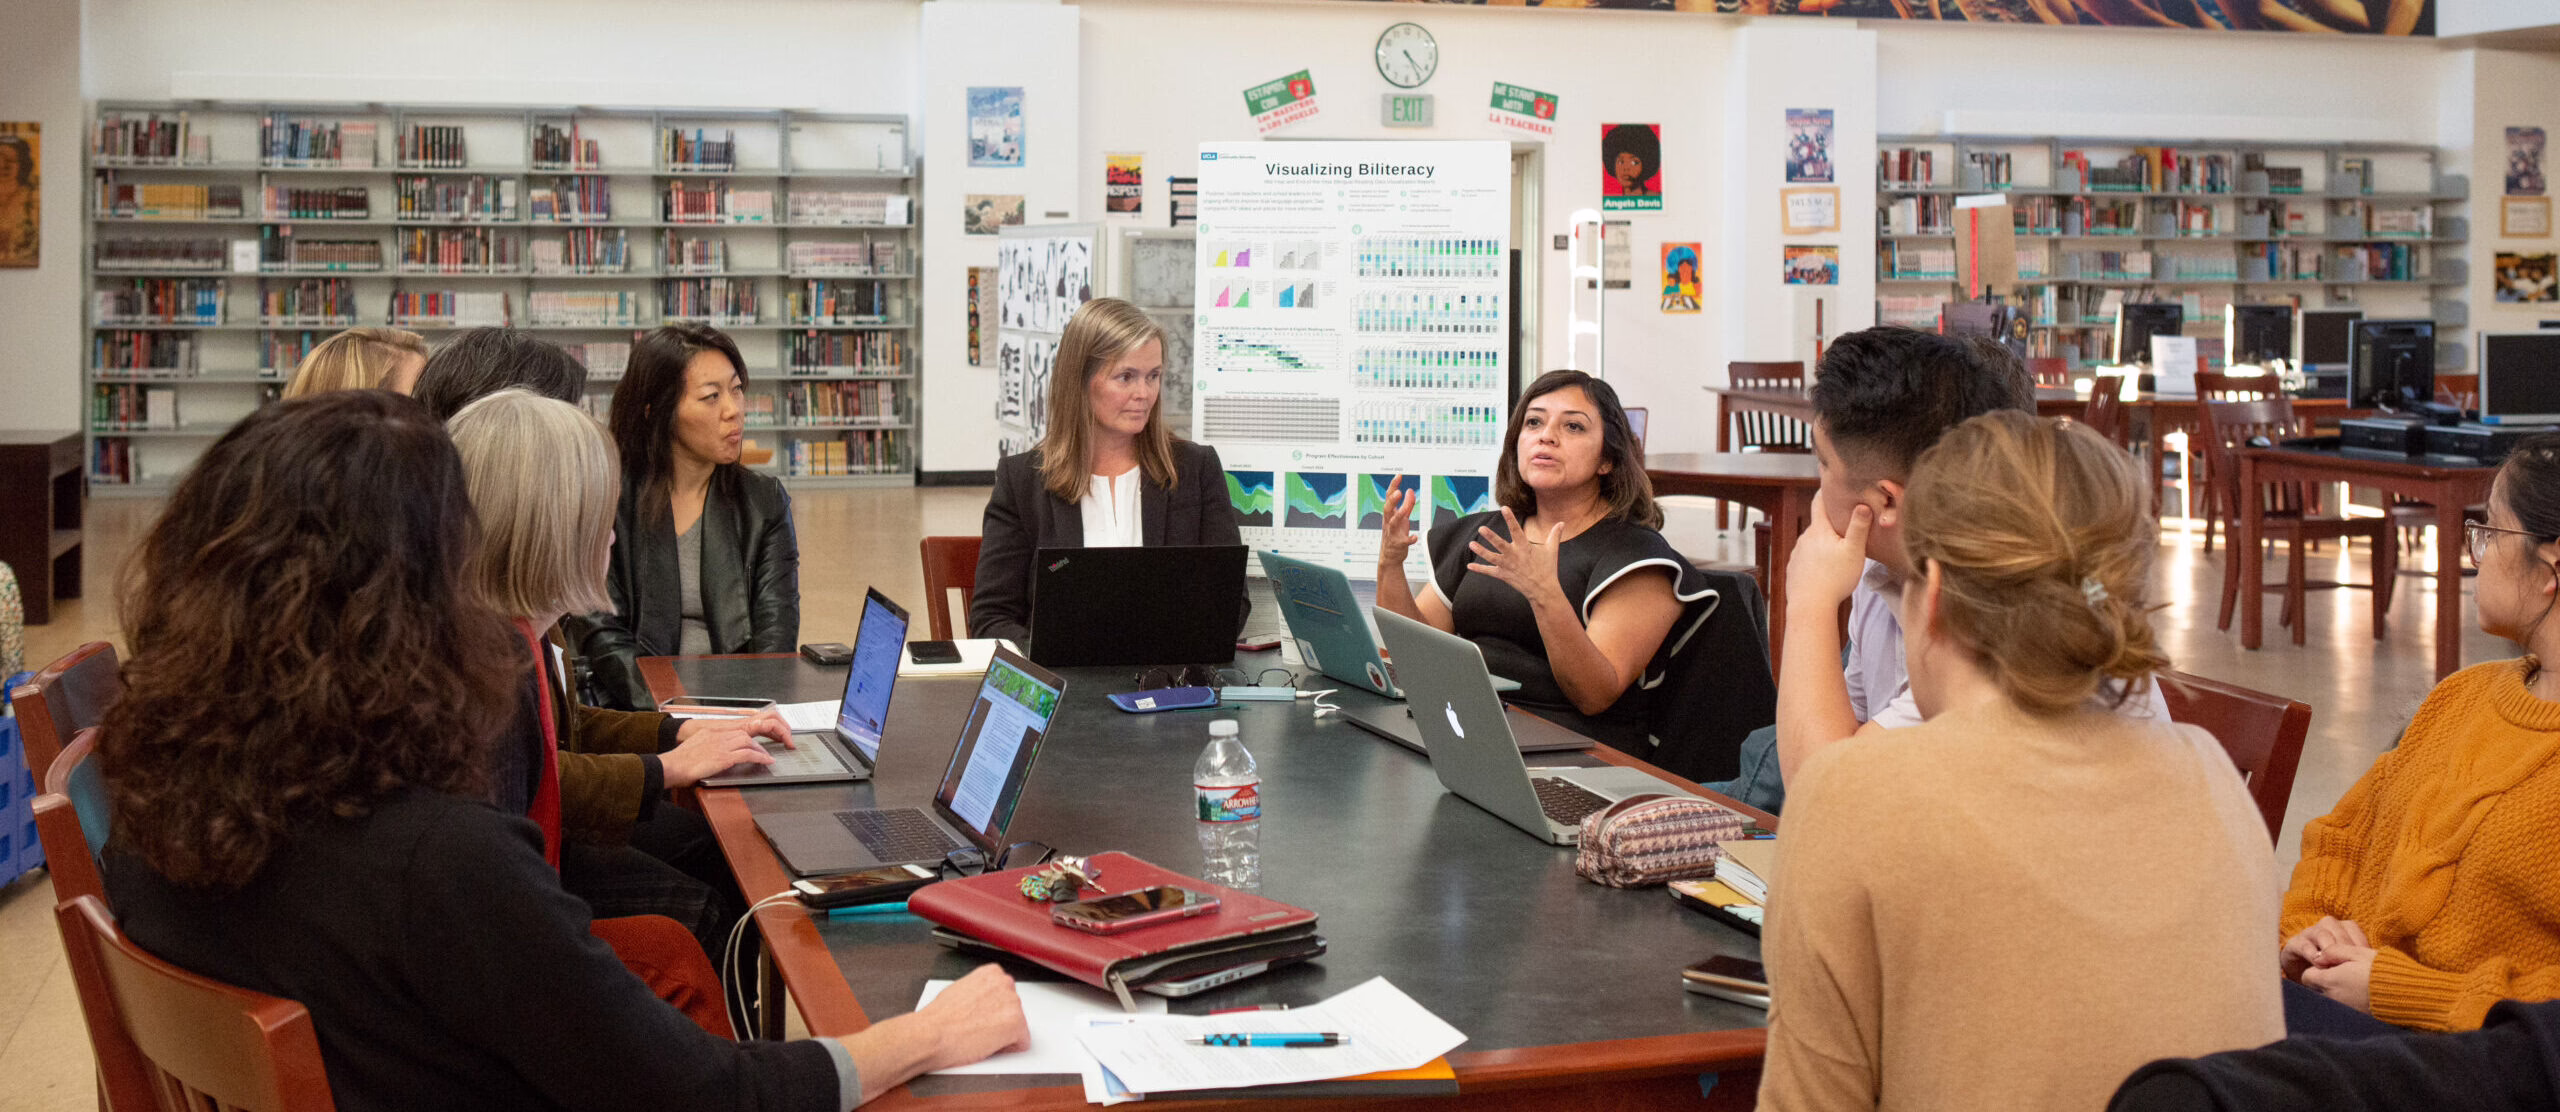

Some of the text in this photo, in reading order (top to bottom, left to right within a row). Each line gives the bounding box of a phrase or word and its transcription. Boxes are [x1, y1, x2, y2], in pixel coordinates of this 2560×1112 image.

[1508, 87, 1536, 102] STAND
[1393, 97, 1424, 122] EXIT
[1489, 113, 1553, 135] LA TEACHERS
[1265, 163, 1435, 178] Visualizing Biliteracy
[1605, 199, 1661, 210] Angela Davis
